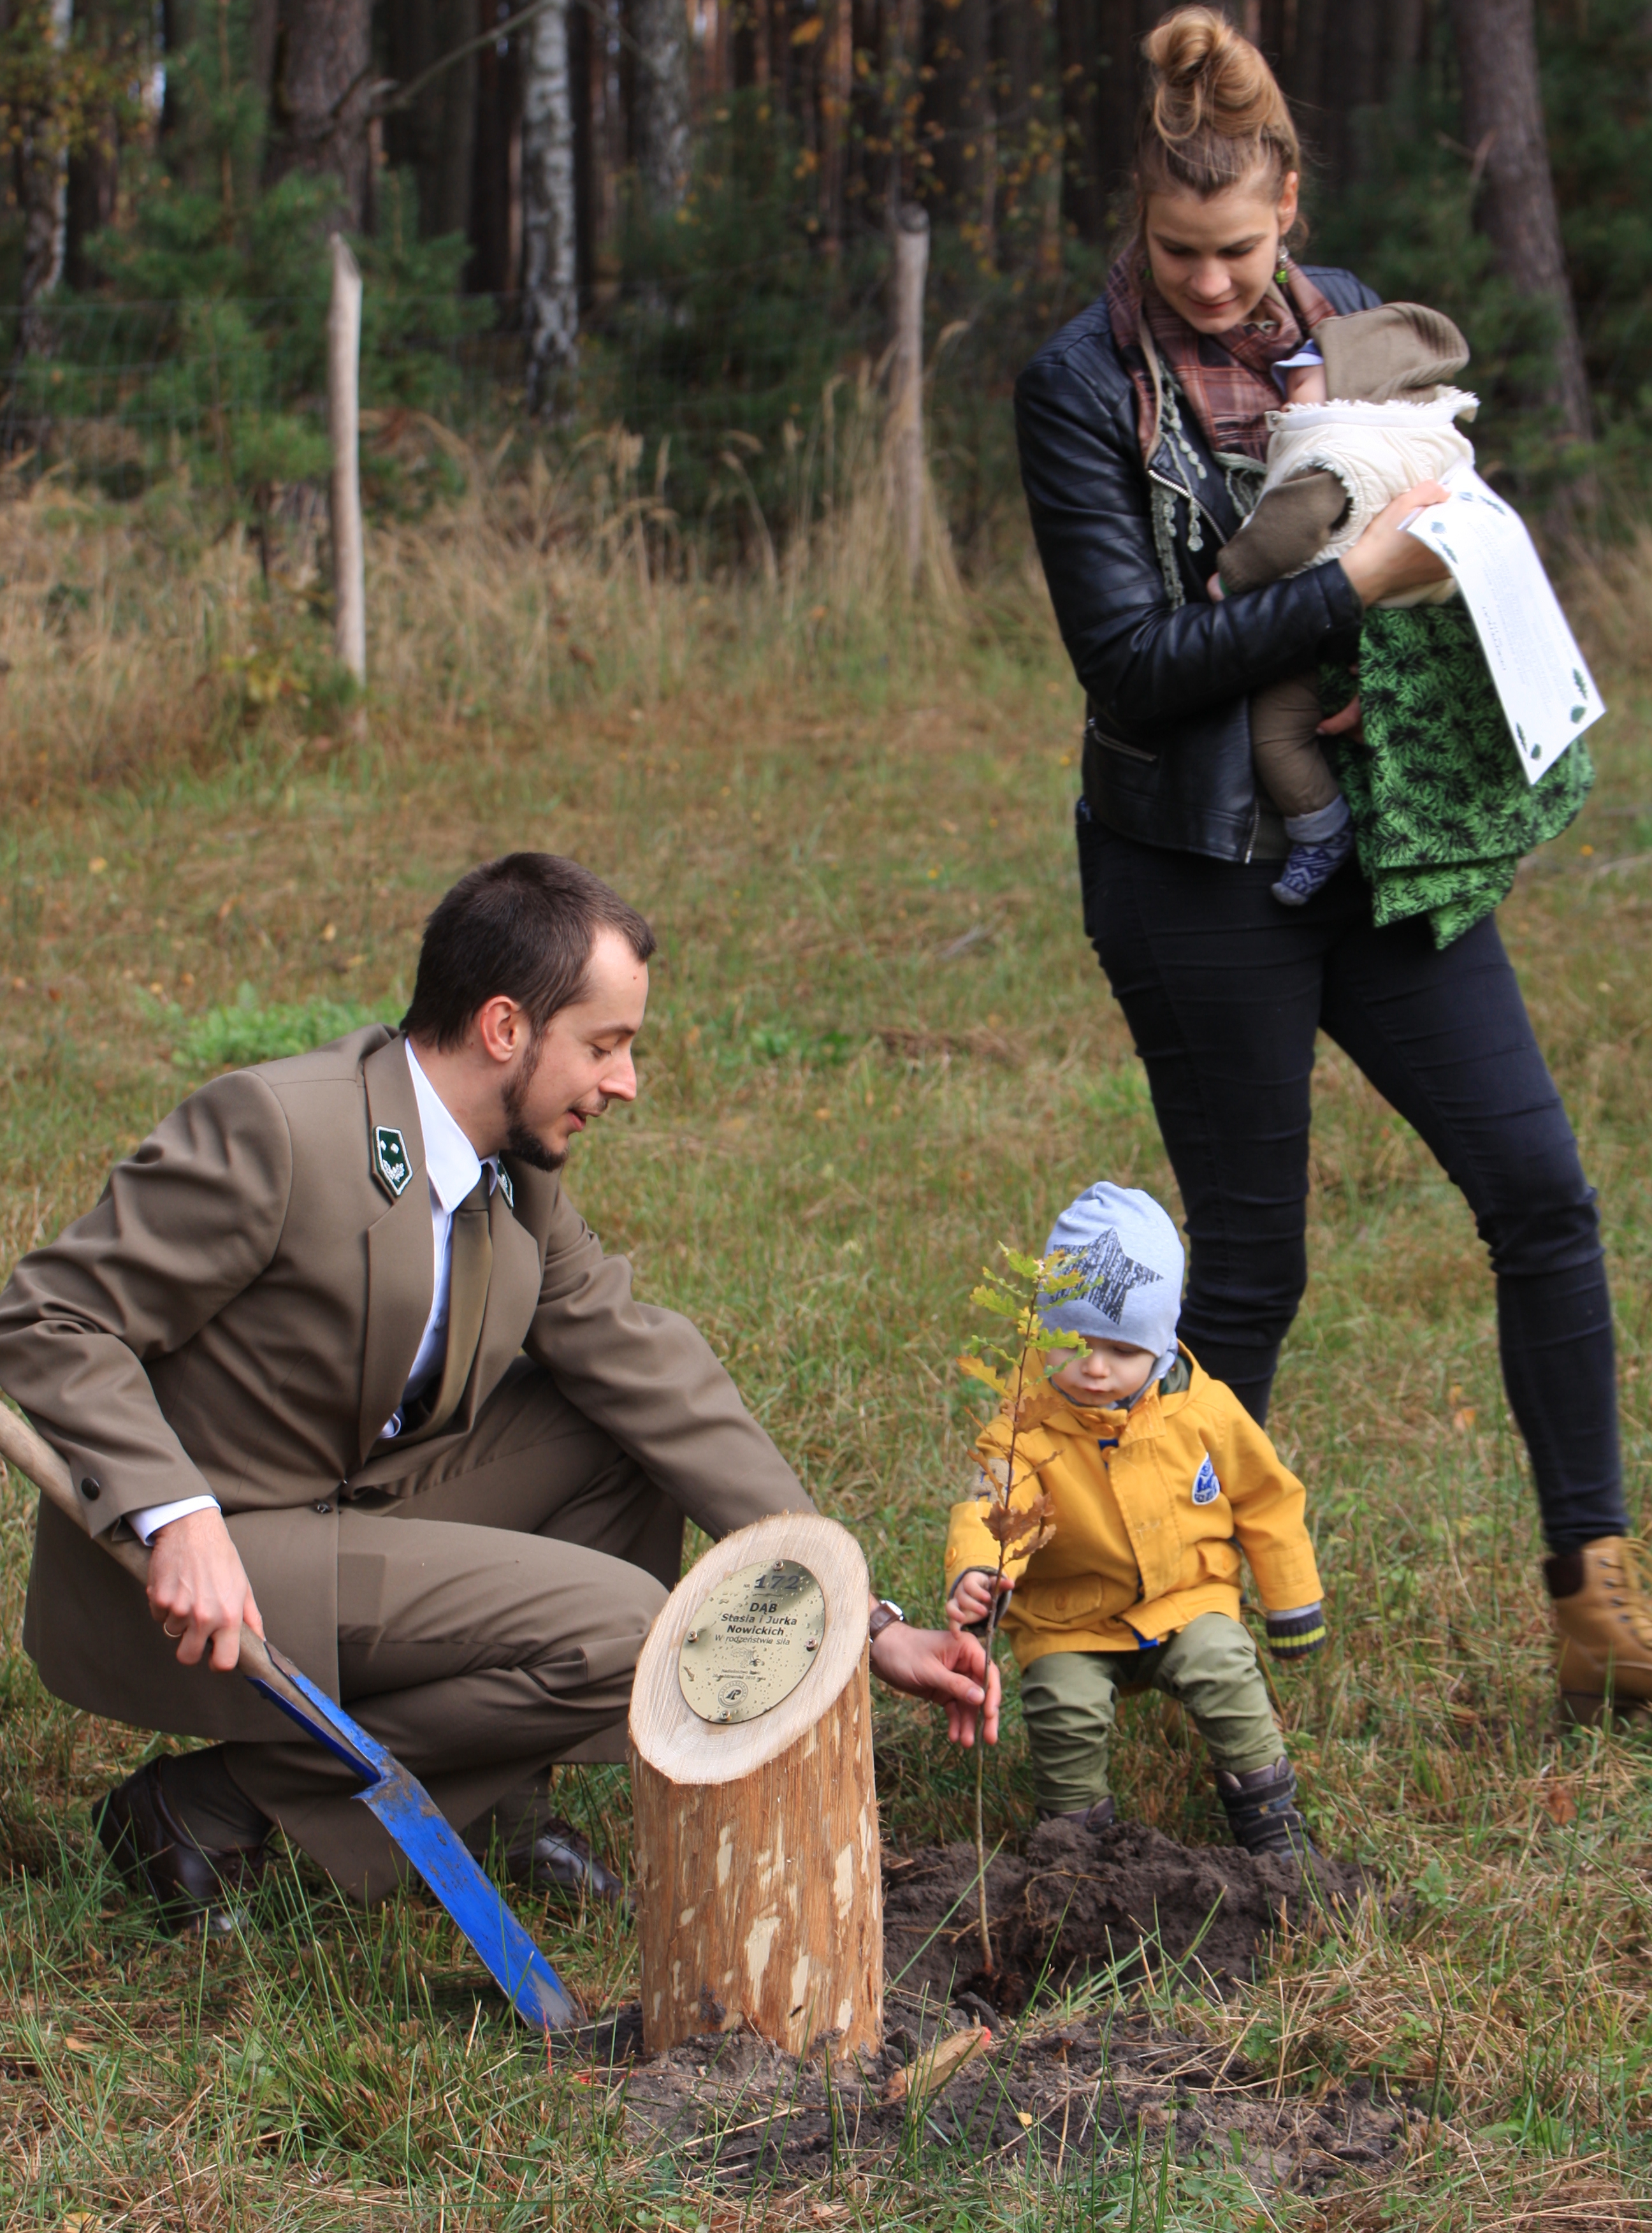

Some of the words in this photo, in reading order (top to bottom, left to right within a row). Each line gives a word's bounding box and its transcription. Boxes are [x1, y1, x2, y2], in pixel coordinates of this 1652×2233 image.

[754, 1574, 800, 1590] 172
[749, 1602, 778, 1615] DĄB
[721, 1613, 755, 1624] Stasia
[765, 1616, 797, 1626] Jurka
[727, 1625, 785, 1636] Nowickich
[725, 1635, 774, 1645] rodzeństwie
